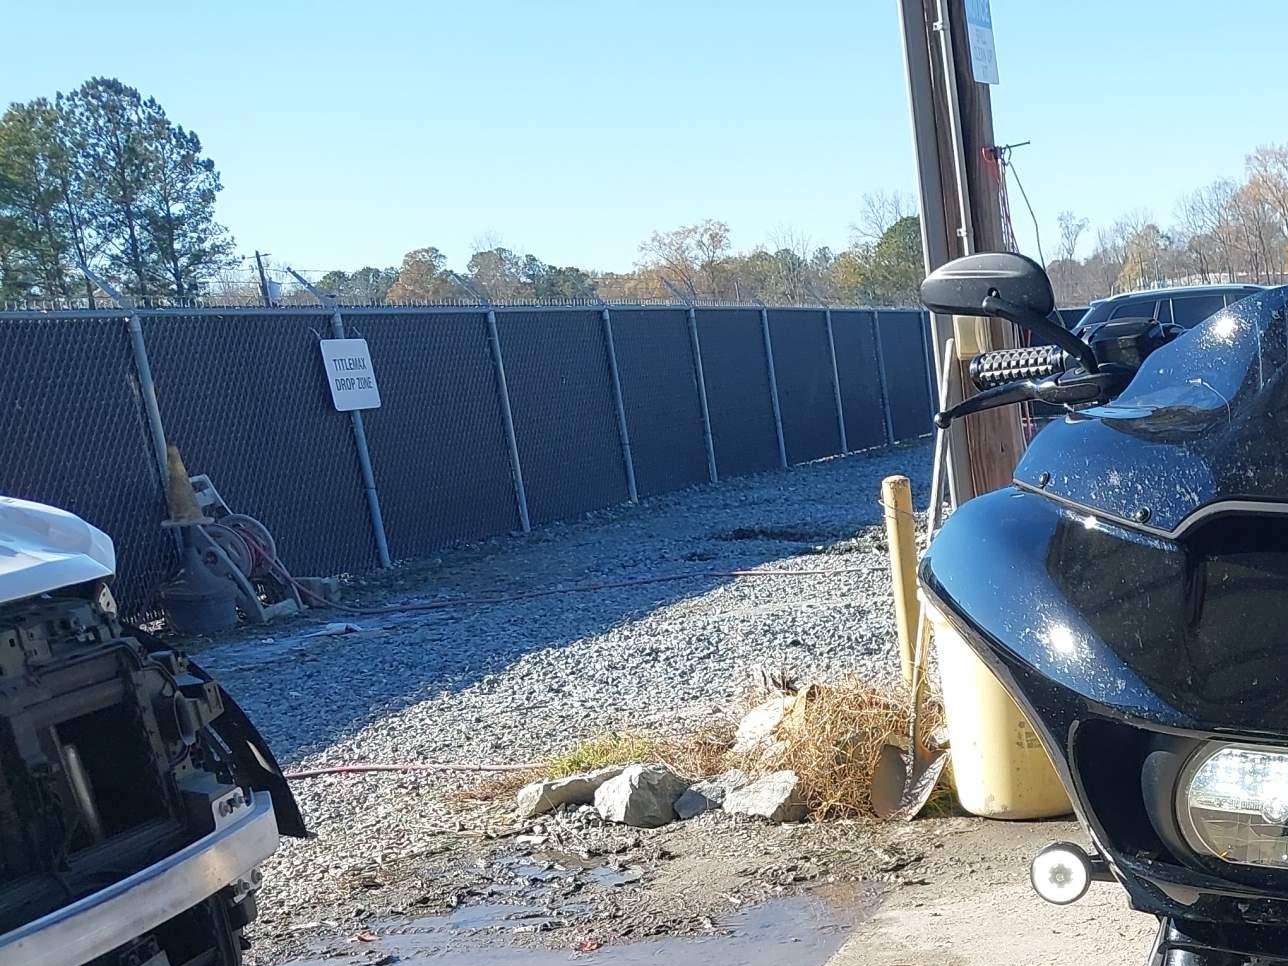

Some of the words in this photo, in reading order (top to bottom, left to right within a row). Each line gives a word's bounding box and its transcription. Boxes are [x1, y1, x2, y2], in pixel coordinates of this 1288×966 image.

[333, 357, 367, 371] TITLEMAX
[335, 378, 355, 391] DROP
[357, 377, 373, 390] ZONE
